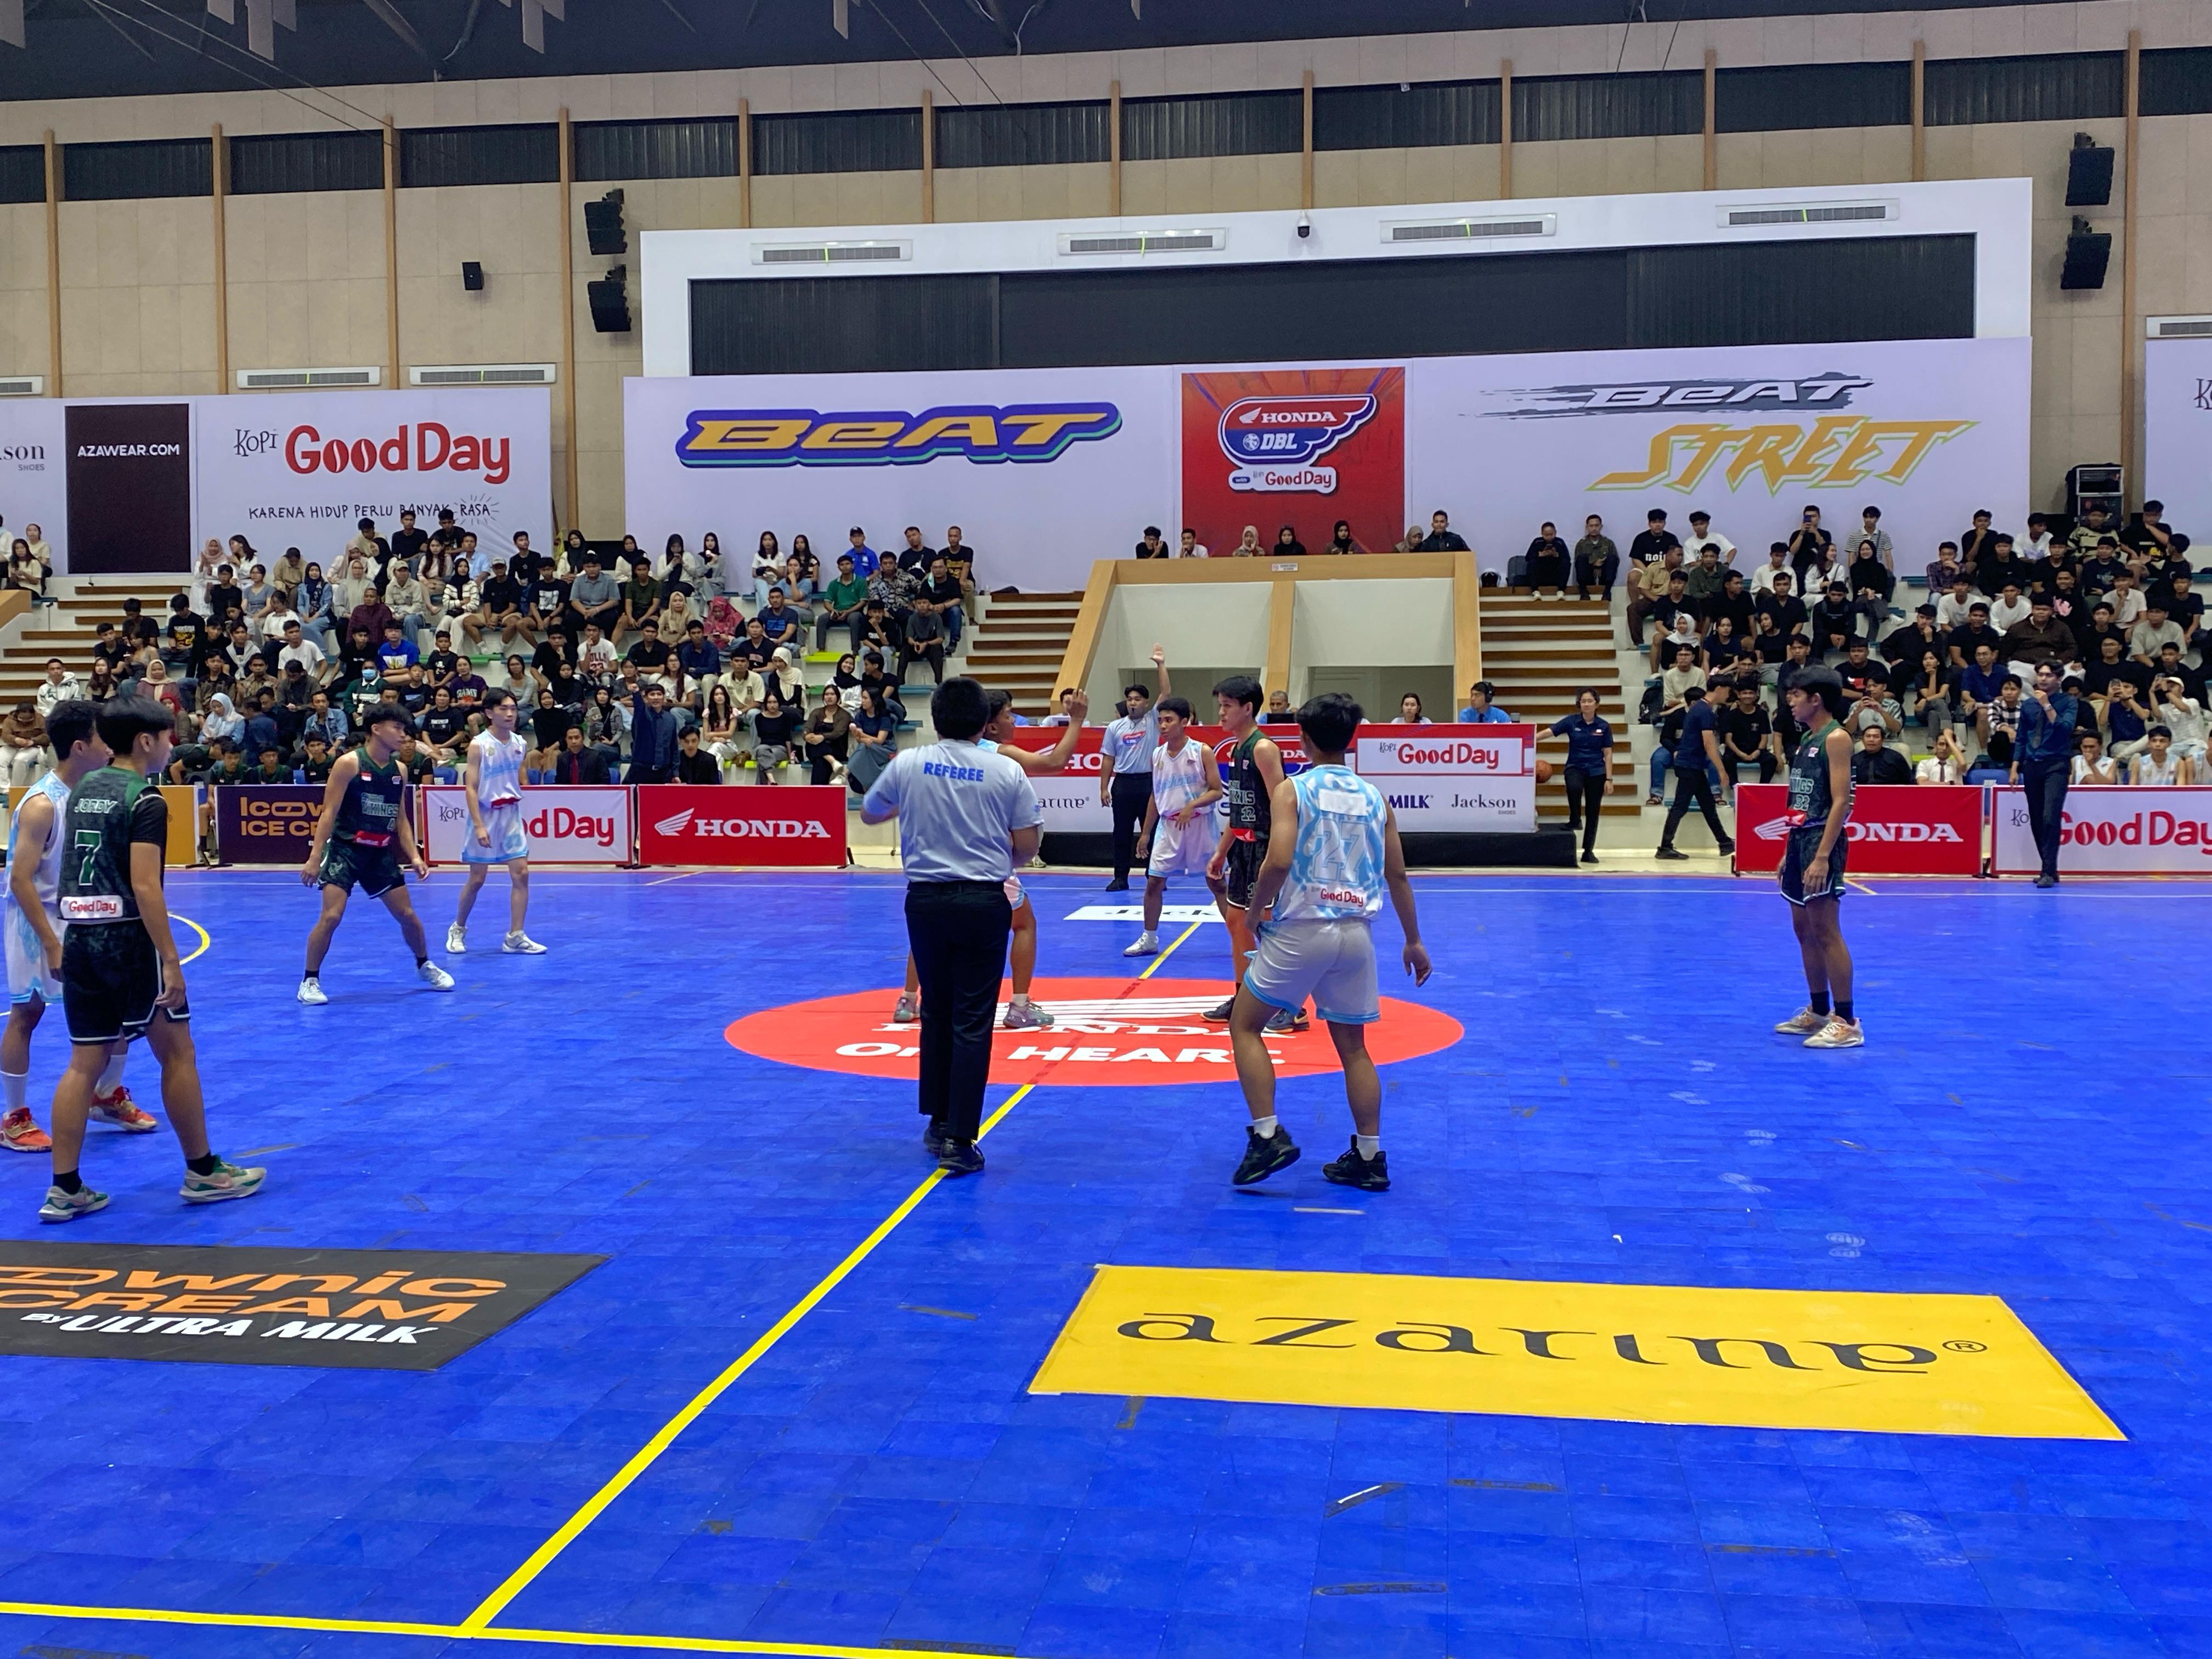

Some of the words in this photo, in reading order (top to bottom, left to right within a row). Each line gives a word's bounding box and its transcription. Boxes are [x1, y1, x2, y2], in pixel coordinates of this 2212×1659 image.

[1261, 411, 1337, 422] HONDA
[77, 443, 180, 457] AZAWEAR.COM
[1261, 433, 1298, 450] DBL
[284, 425, 408, 474] Good
[416, 422, 510, 484] Day
[1585, 415, 1979, 496] STREET
[1265, 471, 1302, 486] Good
[1304, 471, 1332, 488] Day
[249, 506, 305, 520] KARENA
[309, 505, 348, 518] HIDUP
[354, 504, 393, 517] PERLU
[399, 503, 450, 516] BANYAK
[460, 503, 491, 516] RASA
[1064, 753, 1104, 770] HO
[1280, 749, 1307, 758] DA
[1397, 743, 1454, 764] Good
[1457, 743, 1499, 770] Day
[924, 761, 984, 782] REFEREE
[74, 798, 118, 814] JORDY
[1389, 795, 1430, 809] MILK
[1451, 794, 1516, 809] Jackson
[1793, 794, 1810, 811] 32
[1240, 805, 1256, 822] 12
[240, 820, 285, 836] ICE
[554, 807, 614, 847] Day
[694, 819, 831, 838] HONDA
[1843, 822, 1963, 842] ONDA
[74, 829, 102, 886] 7
[1312, 817, 1369, 884] 27
[69, 901, 95, 913] Good
[96, 900, 117, 915] Day
[1344, 891, 1363, 907] Day
[59, 1314, 253, 1336] ULTRA
[260, 1320, 439, 1344] MILK
